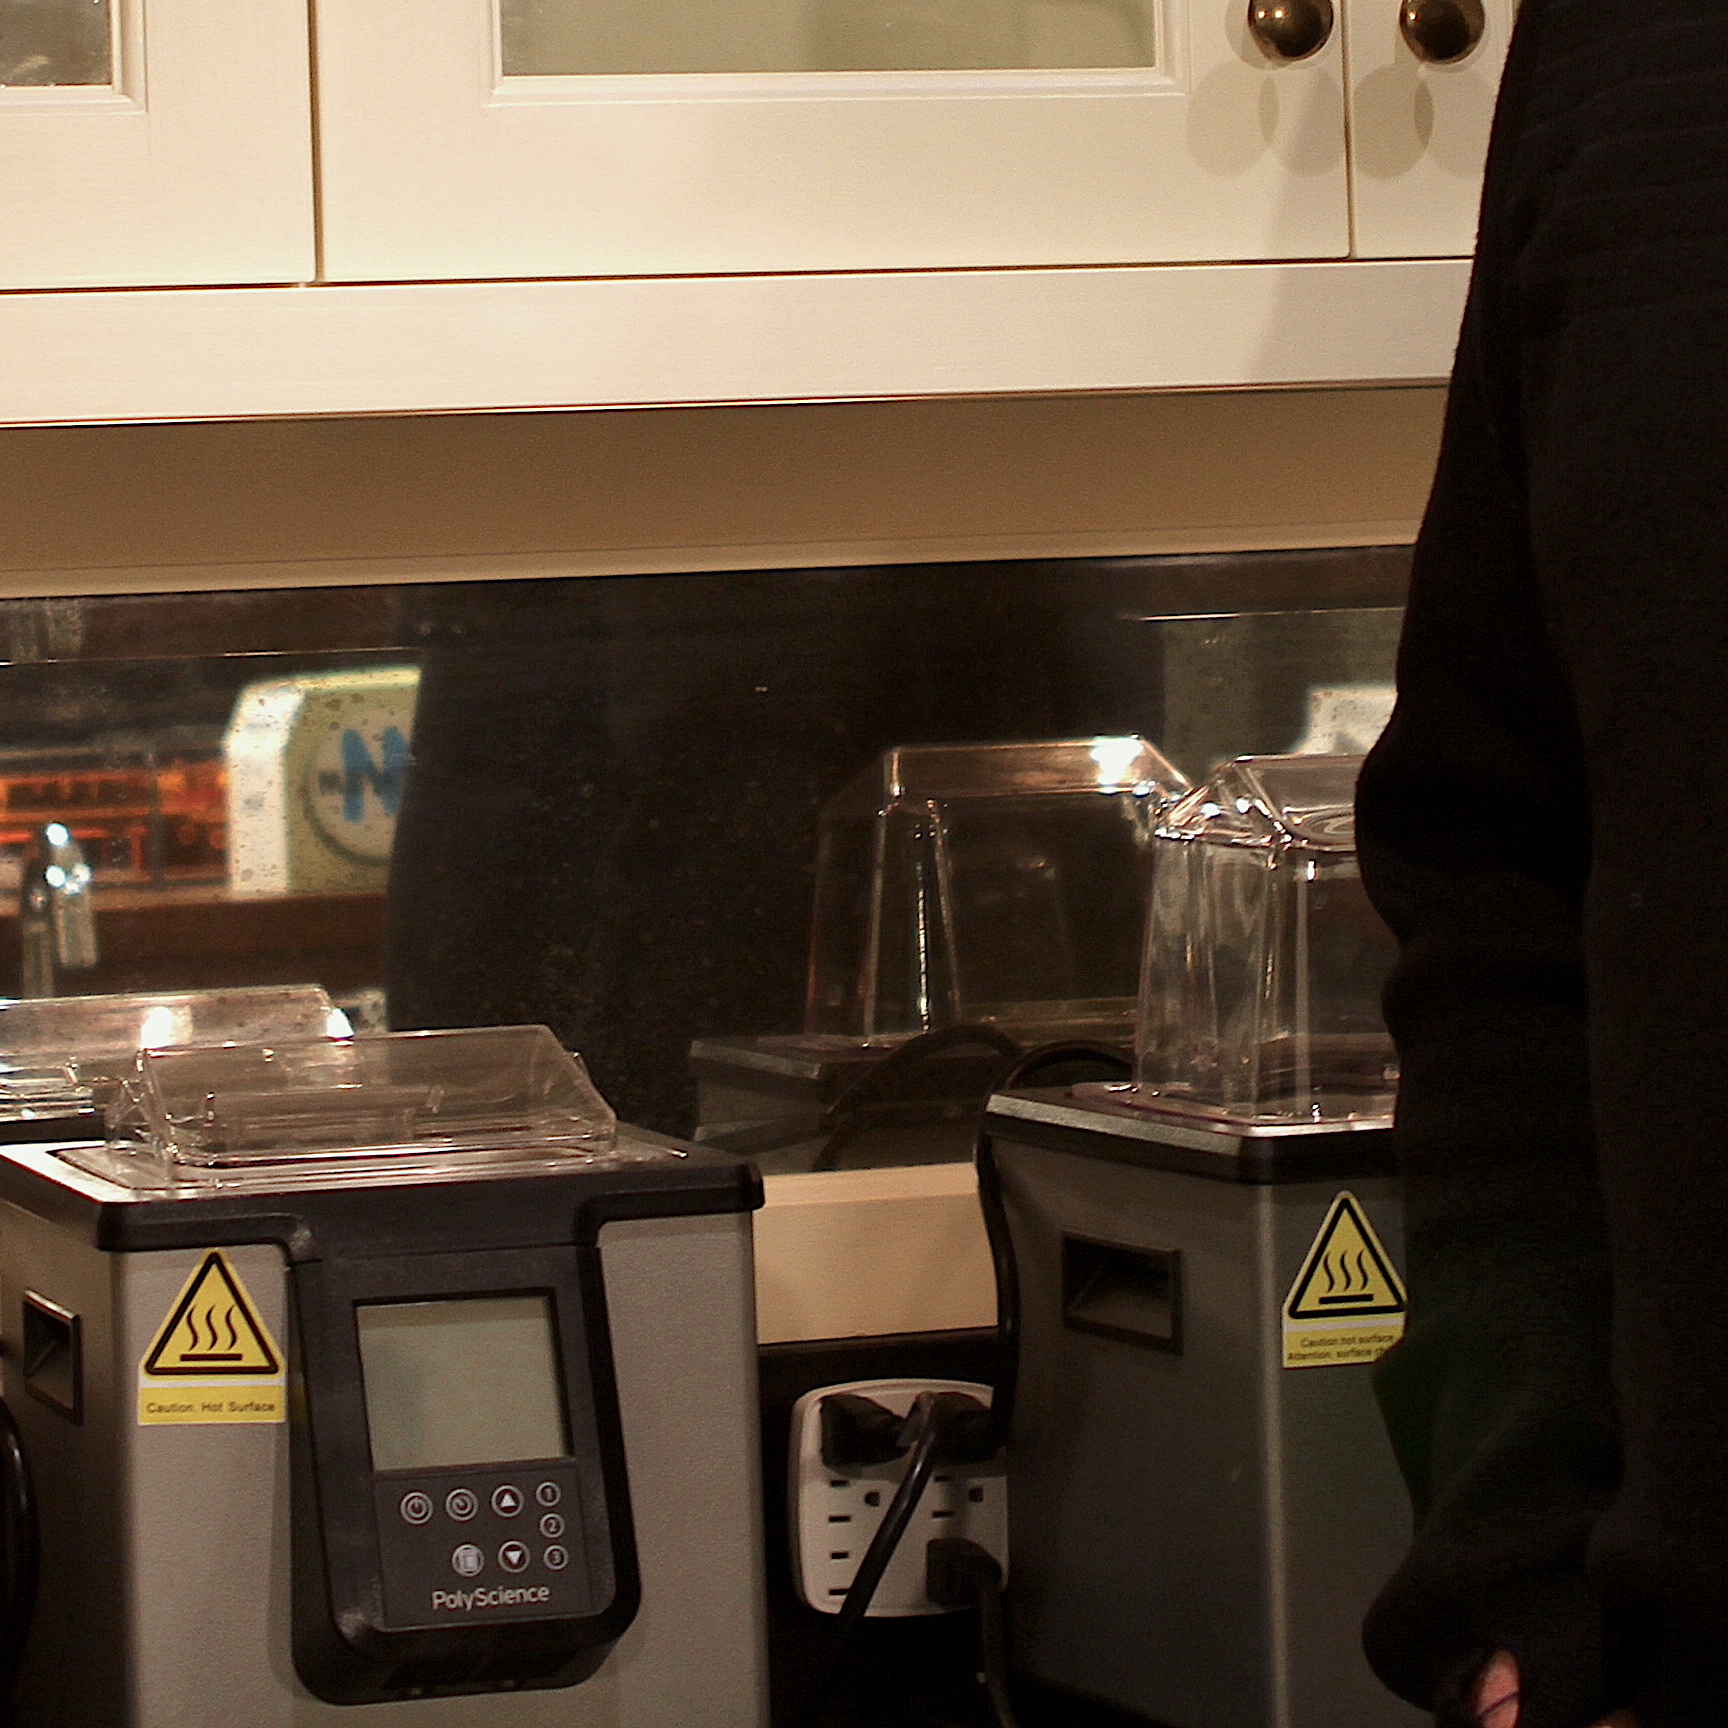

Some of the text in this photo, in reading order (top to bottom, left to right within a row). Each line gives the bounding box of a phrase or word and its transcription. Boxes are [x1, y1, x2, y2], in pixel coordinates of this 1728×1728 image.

[201, 1402, 223, 1413] Hot
[228, 1401, 276, 1413] Surface
[431, 1585, 551, 1611] PolyScience
